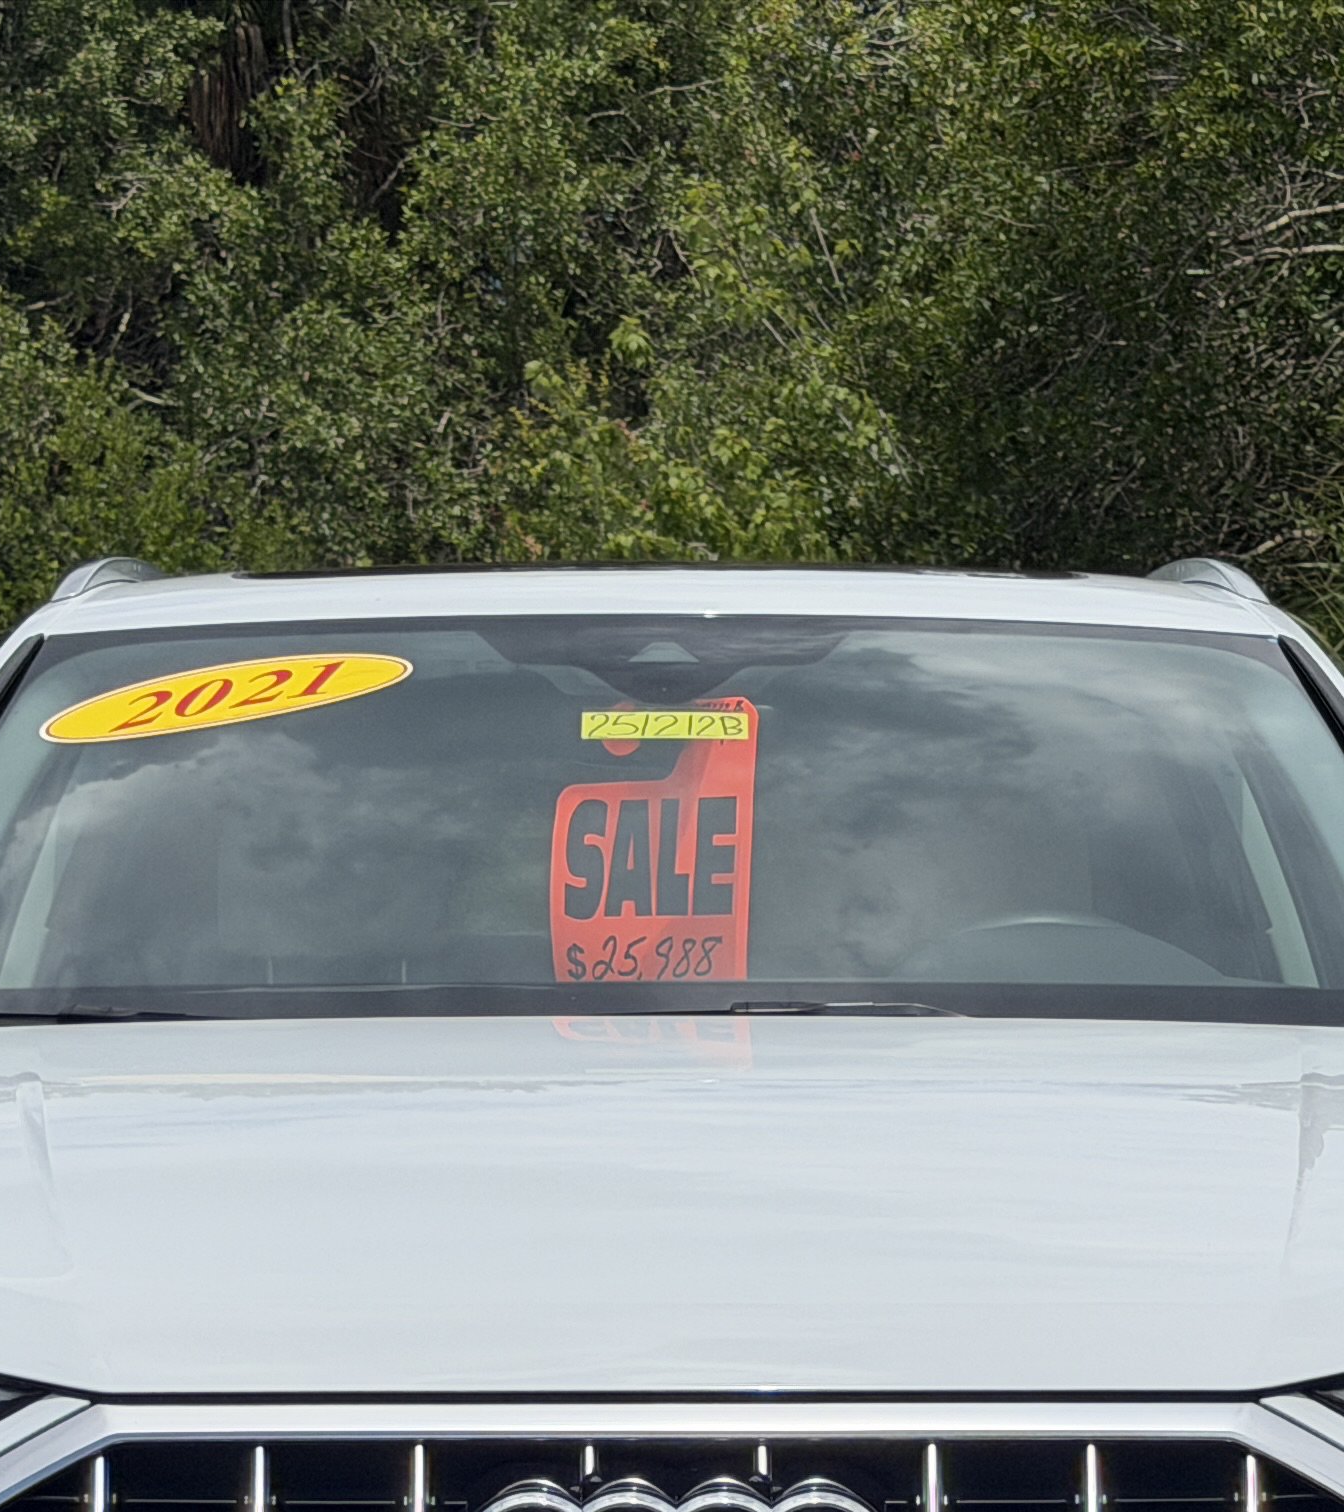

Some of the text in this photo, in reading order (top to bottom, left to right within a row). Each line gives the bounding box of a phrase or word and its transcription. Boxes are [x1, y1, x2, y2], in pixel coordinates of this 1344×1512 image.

[108, 661, 346, 733] 2021
[564, 796, 737, 919] SALE
[567, 935, 723, 981] $25,988
